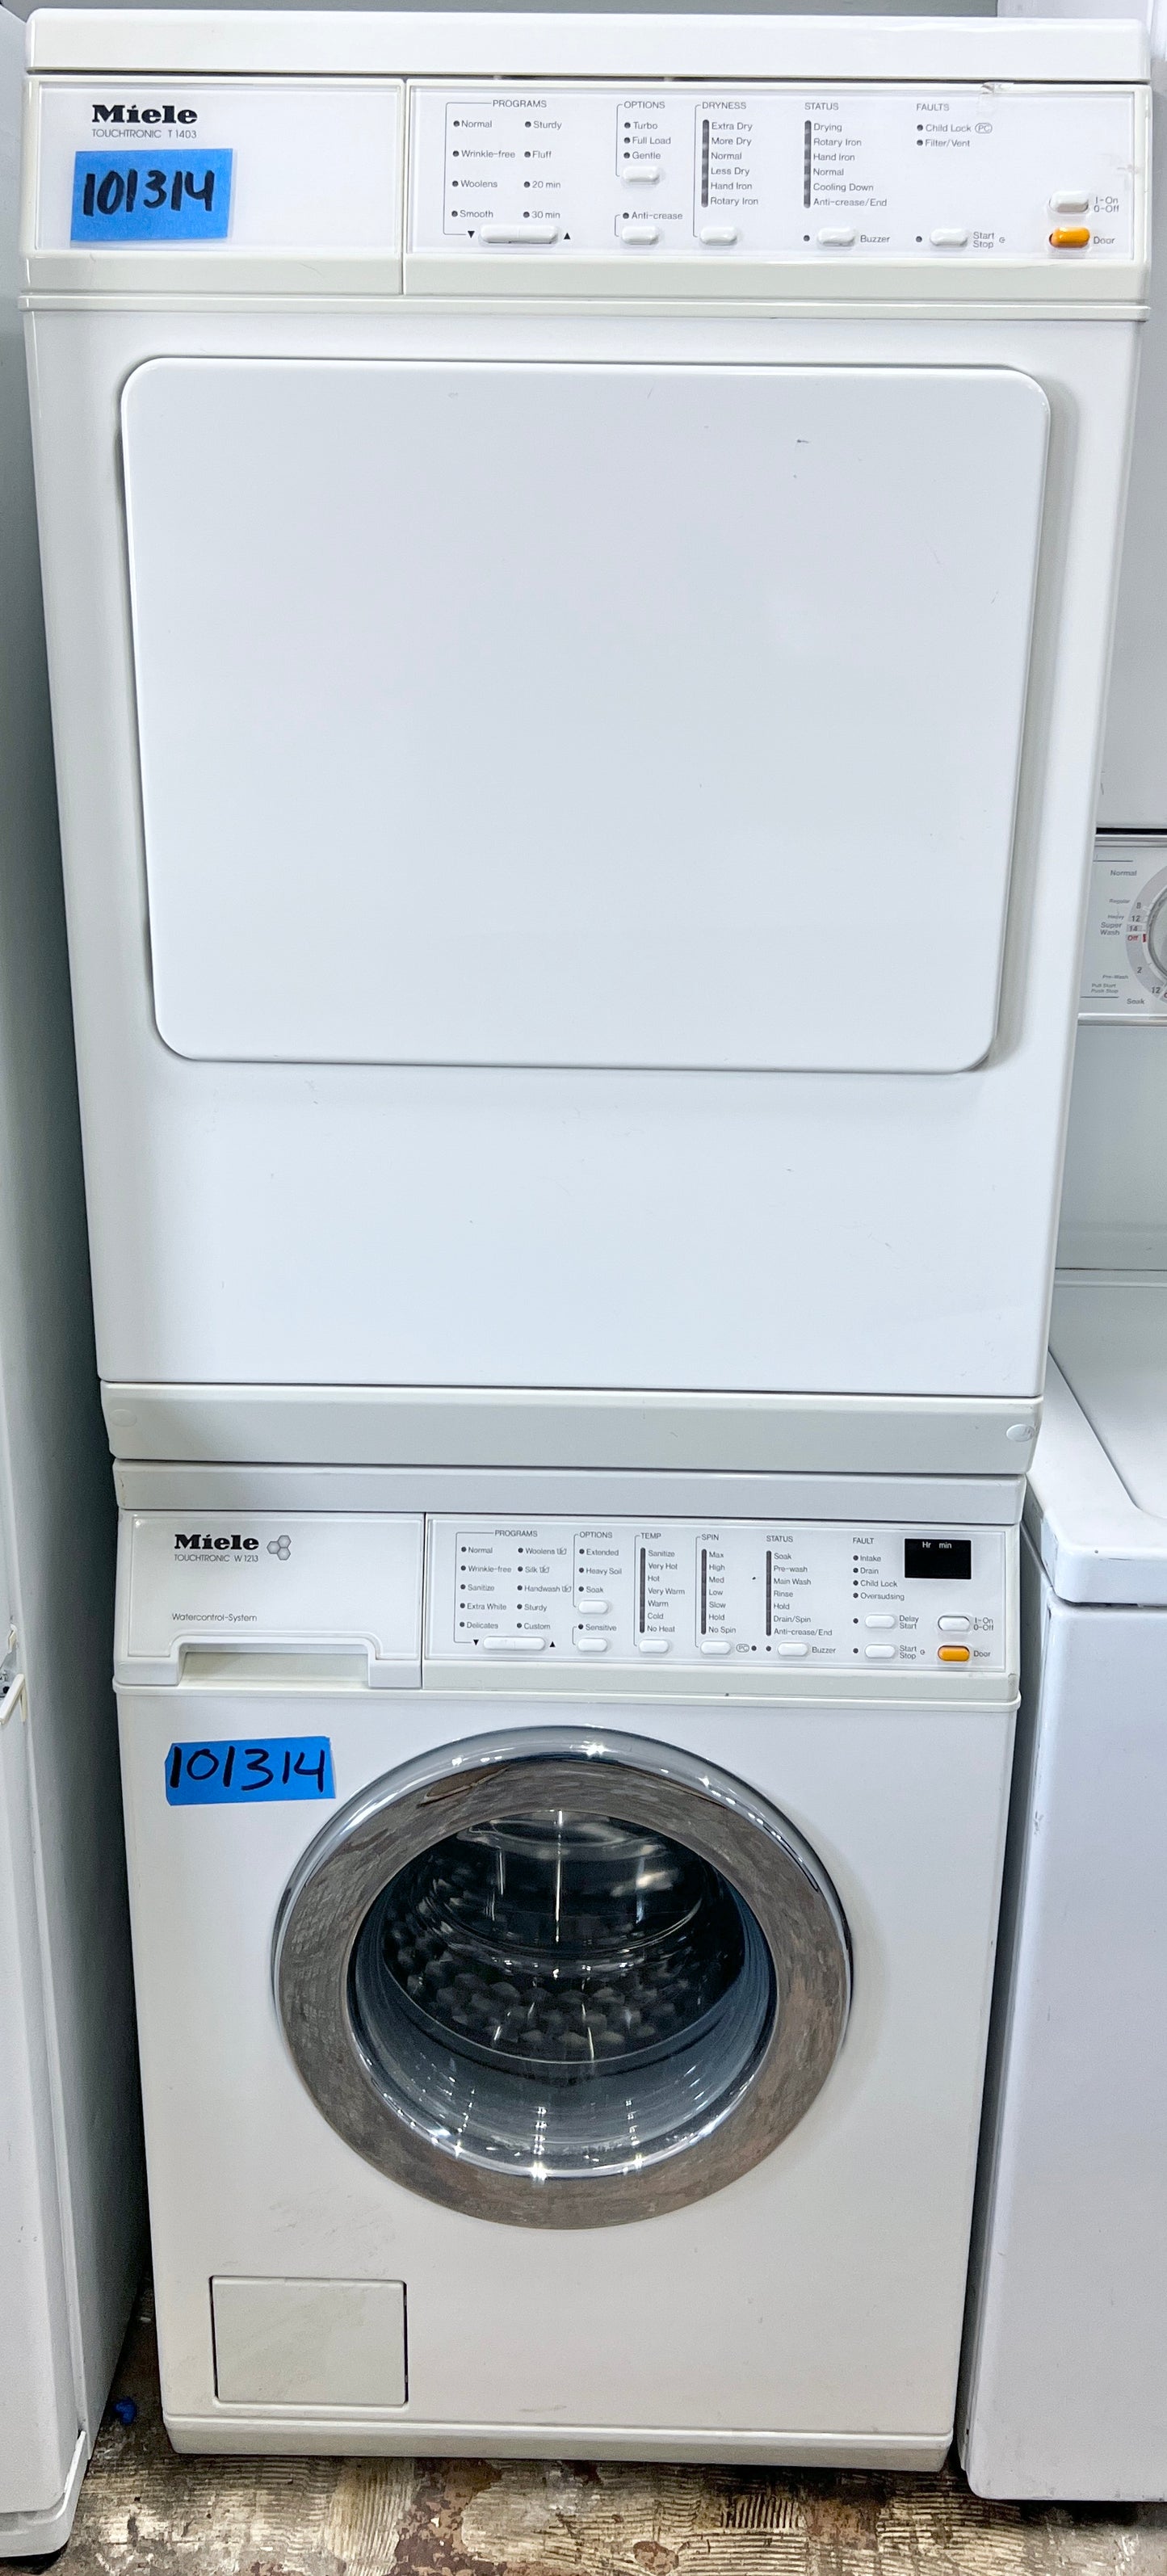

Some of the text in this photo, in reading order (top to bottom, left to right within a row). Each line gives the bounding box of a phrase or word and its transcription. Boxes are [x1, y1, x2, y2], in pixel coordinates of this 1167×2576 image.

[492, 100, 547, 108] PROGRAMS
[623, 101, 665, 109] OPTIONS
[702, 101, 746, 109] DRYNESS
[804, 103, 839, 111] STATUS
[916, 103, 950, 111] FAULTS
[92, 104, 198, 124] Miele
[461, 120, 492, 128] Normal
[533, 120, 562, 130] Sturdy
[633, 121, 658, 129] Turbo
[712, 122, 753, 132] Extra Dry
[814, 124, 842, 133] Drying
[926, 124, 948, 132] Child
[951, 124, 972, 132] Lock
[92, 129, 197, 139] TOUCHTRONIC T 1403
[632, 137, 671, 145] Full Load
[712, 137, 751, 146] More Dry
[813, 138, 862, 148] Rotary Iron
[926, 138, 970, 148] Filter/Vent
[461, 149, 515, 158] Wrinkle-free
[532, 150, 552, 158] Fluff
[632, 151, 661, 160] Gentle
[712, 152, 741, 160] Normal
[711, 167, 749, 177] Less Dry
[813, 168, 844, 176] Normal
[460, 179, 497, 188] Woolens
[532, 180, 561, 189] 20 min
[711, 182, 753, 190] Hand Iron
[813, 183, 874, 193] Cooling Down
[82, 169, 215, 217] 101314
[711, 197, 758, 207] Rotary Iron
[813, 198, 887, 207] Anti-crease/End
[460, 210, 493, 218] Smooth
[531, 211, 560, 219] 30 min
[632, 212, 682, 221] Anti-crease
[860, 235, 890, 243] Buzzer
[973, 231, 994, 240] Start
[973, 240, 993, 249] Stop
[1094, 237, 1115, 245] Door
[174, 1534, 259, 1551] Miele
[526, 1548, 556, 1556] Woolens
[174, 1554, 230, 1562] TOUCHTRONIC
[244, 1554, 258, 1562] 1213
[586, 1567, 607, 1576] Heavy
[648, 1563, 664, 1572] Very
[709, 1564, 725, 1572] High
[468, 1584, 495, 1592] Sanitize
[524, 1585, 560, 1593] Handwash
[648, 1588, 664, 1597] Very
[860, 1592, 905, 1601] Oversudsing
[467, 1603, 485, 1611] Extra
[524, 1603, 548, 1612] Sturdy
[172, 1612, 257, 1623] Watercontrol-System
[774, 1616, 811, 1624] Drain/Spin
[900, 1616, 919, 1624] Delay
[586, 1624, 617, 1632] Sensitive
[720, 1627, 736, 1635] Spin
[774, 1628, 833, 1637] Anti-crease/End
[812, 1646, 836, 1654] Buzzer
[170, 1746, 325, 1792] 101314
